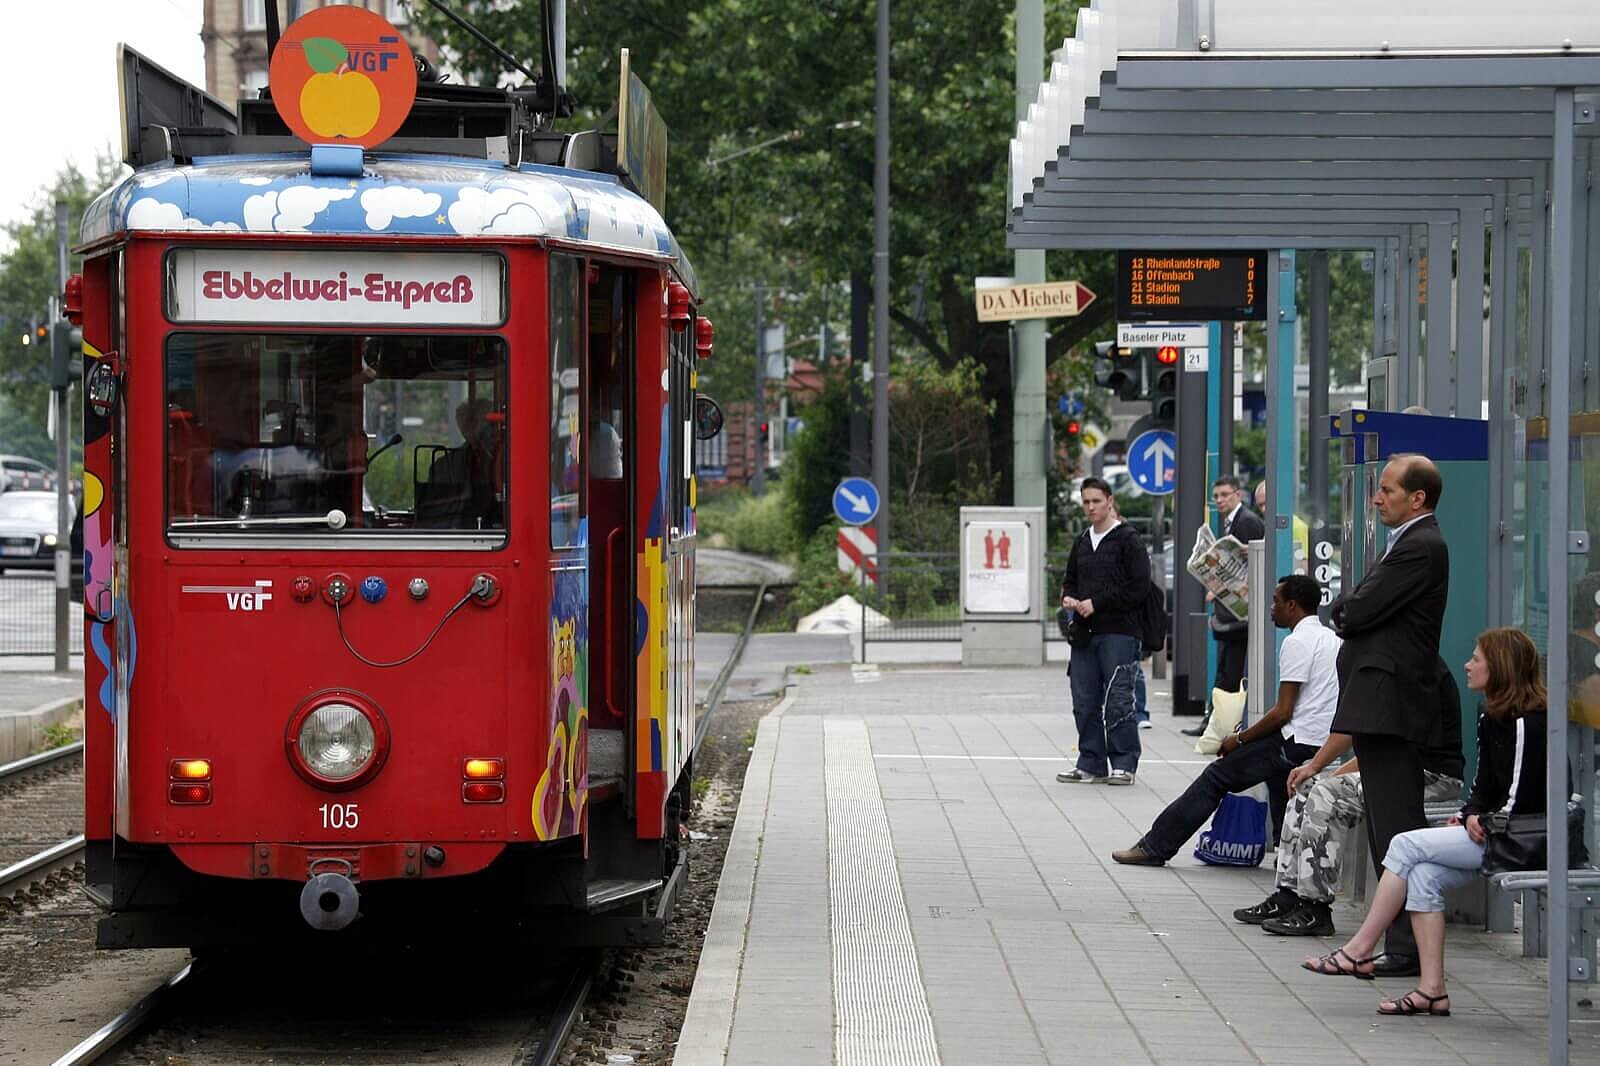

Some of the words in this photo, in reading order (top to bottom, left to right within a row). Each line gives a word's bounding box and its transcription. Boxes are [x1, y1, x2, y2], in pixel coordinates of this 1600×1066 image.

[347, 36, 399, 72] VGF
[1131, 258, 1144, 270] 12
[1247, 258, 1255, 270] 0
[1131, 270, 1143, 281] 16
[1146, 270, 1195, 281] Offenbach
[1247, 270, 1255, 281] 0
[202, 270, 474, 310] Ebbelwei-Expreß
[1131, 282, 1143, 293] 21
[1146, 282, 1181, 293] Stadion
[1247, 282, 1254, 293] 1
[982, 294, 1007, 310] DA
[1010, 287, 1072, 308] Michele
[1131, 294, 1143, 305] 21
[1146, 294, 1180, 305] Stadion
[1247, 294, 1254, 305] 7
[1122, 332, 1159, 343] Baseler
[1161, 331, 1186, 342] Platz
[1188, 354, 1200, 365] 21
[226, 580, 273, 611] VGF
[318, 803, 359, 829] 105
